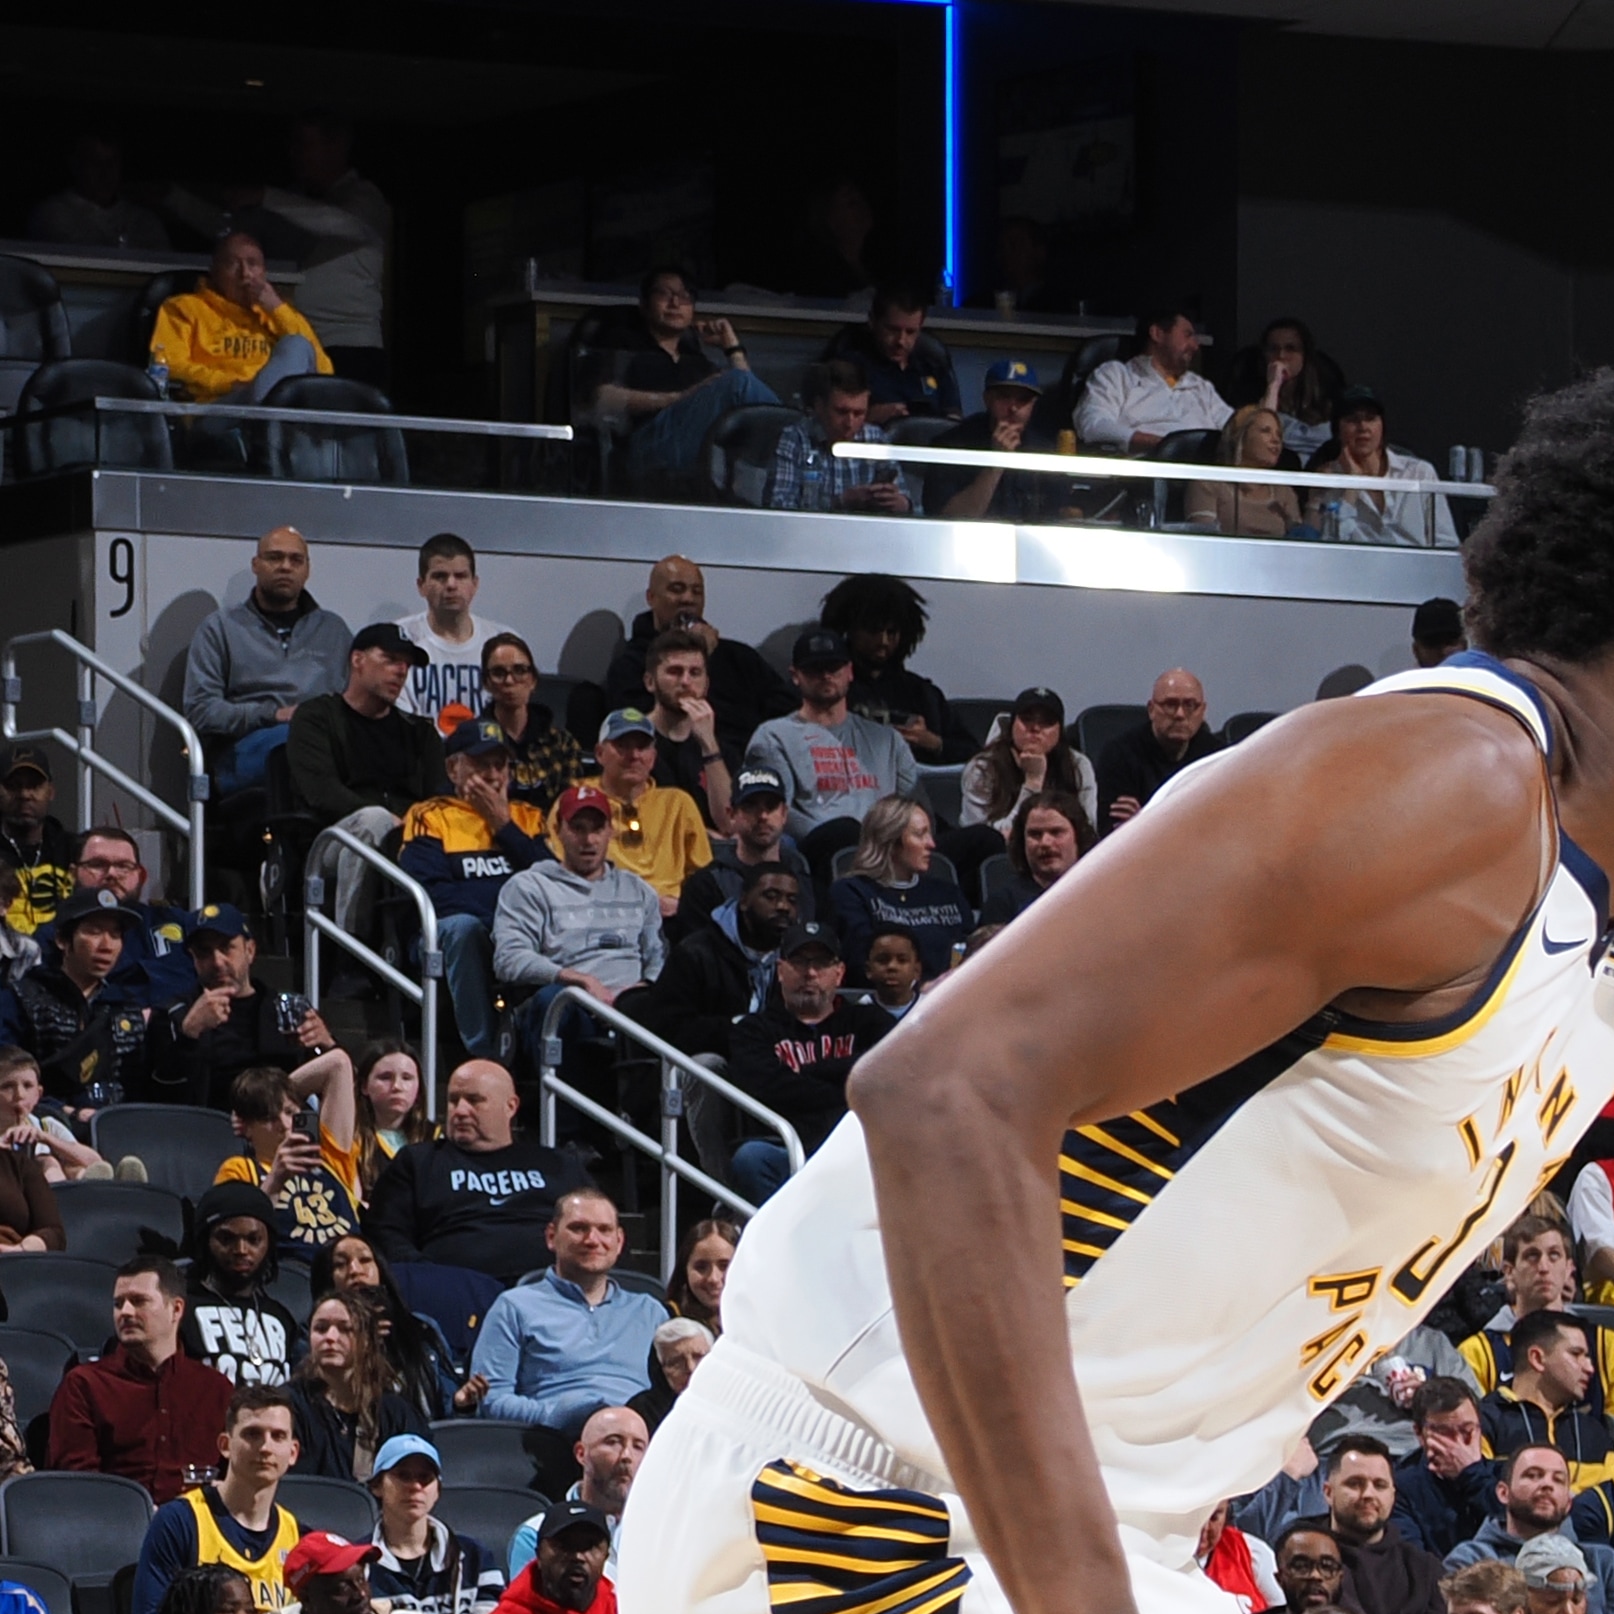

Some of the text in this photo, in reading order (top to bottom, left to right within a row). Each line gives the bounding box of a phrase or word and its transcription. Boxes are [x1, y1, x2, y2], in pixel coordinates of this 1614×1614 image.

[222, 335, 269, 359] PACER
[109, 538, 134, 618] 9
[412, 663, 490, 719] PACER
[461, 856, 511, 879] PACE
[450, 1169, 546, 1195] PACERS
[192, 1306, 286, 1364] FEAR
